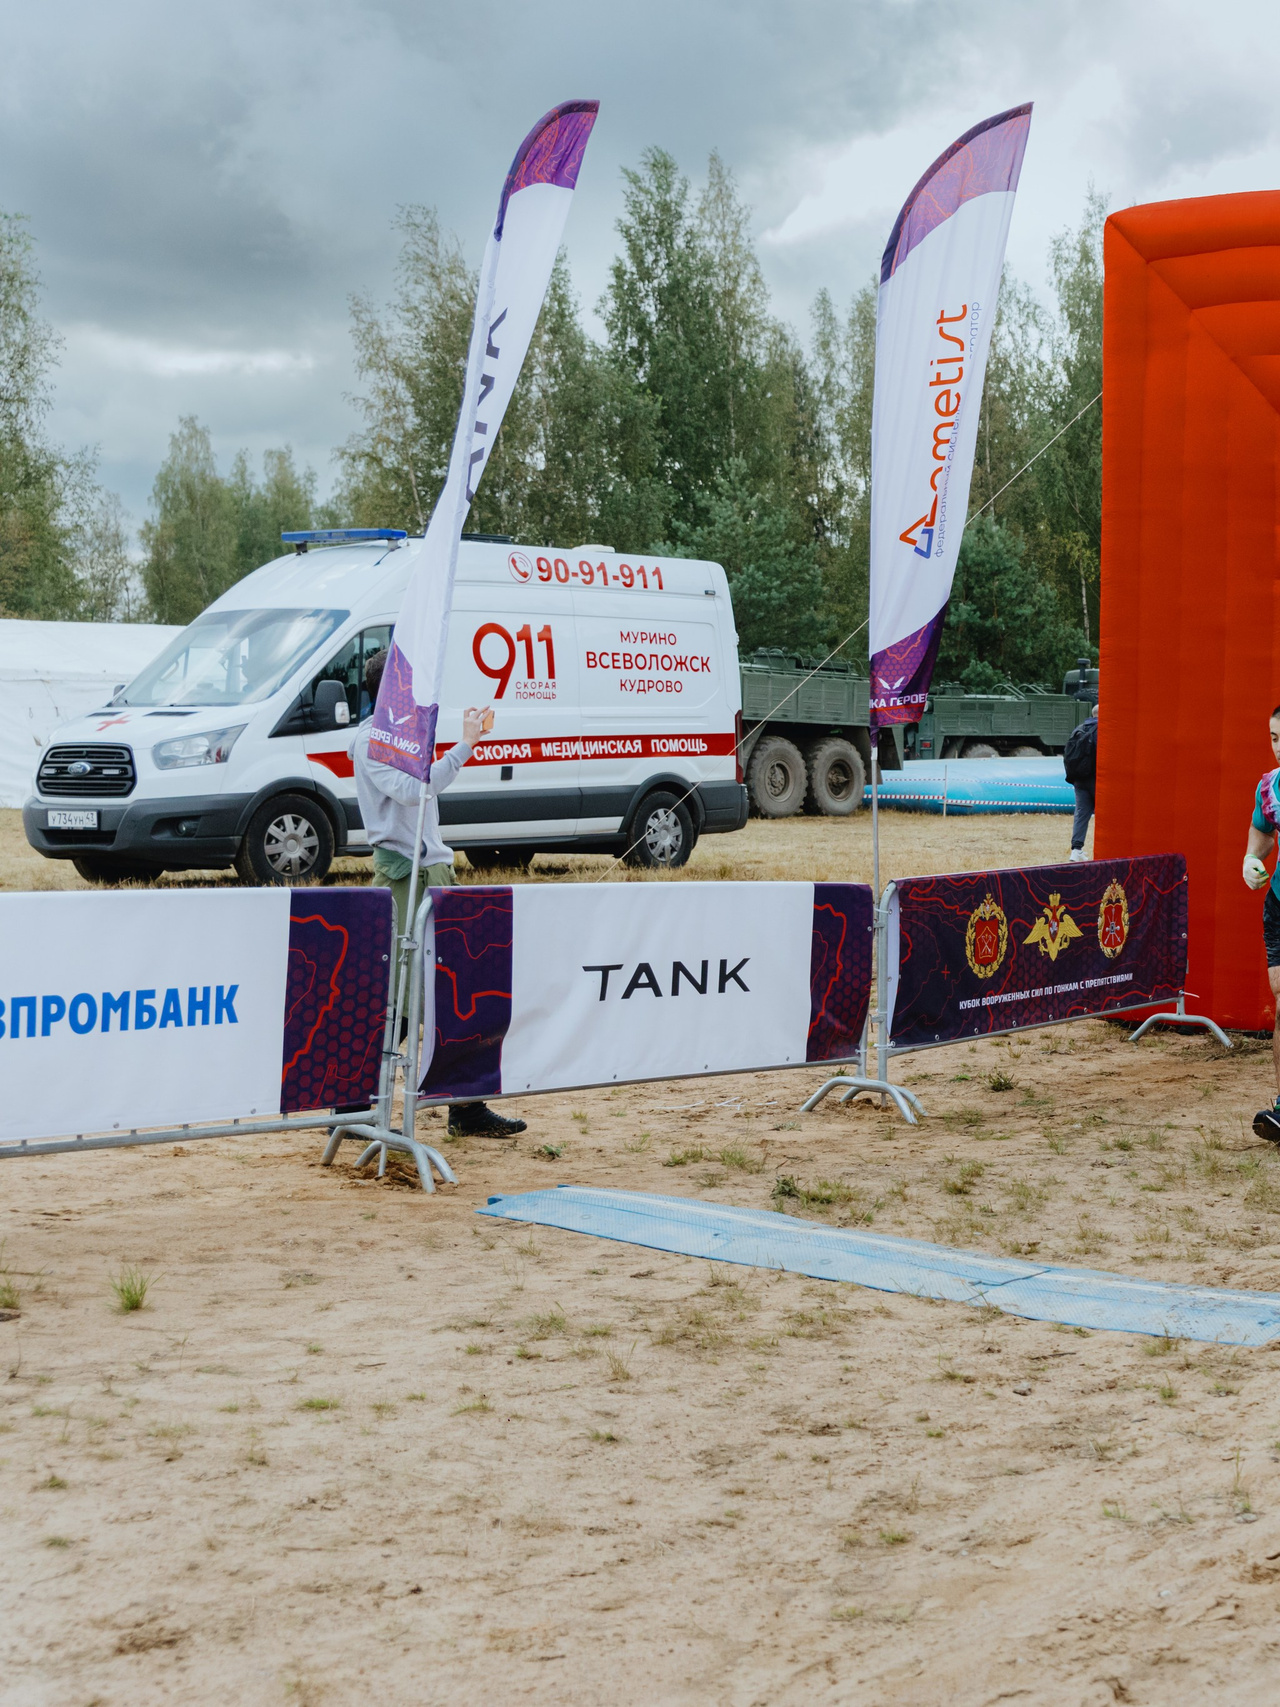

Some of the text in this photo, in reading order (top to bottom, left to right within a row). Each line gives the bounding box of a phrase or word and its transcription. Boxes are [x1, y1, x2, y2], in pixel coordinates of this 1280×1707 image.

[536, 557, 664, 590] 90-91-911
[620, 631, 677, 645] МУРИНО
[472, 622, 556, 699] 911
[586, 651, 711, 673] ВСЕВОЛОЖСК
[515, 681, 557, 690] СКОРАЯ
[515, 691, 557, 700] ПОМОЩЬ
[620, 679, 683, 694] КУДРОВО
[473, 738, 708, 760] СКОРАЯ МЕДИЦИНСКАЯ ПОМОЩЬ
[582, 957, 751, 1002] TANK
[959, 972, 1133, 1010] КУБОК ВООРУЖЕННЫХ СИЛ ПО ГОНКАМ С ПРЕПЯТСТВИЯМИ
